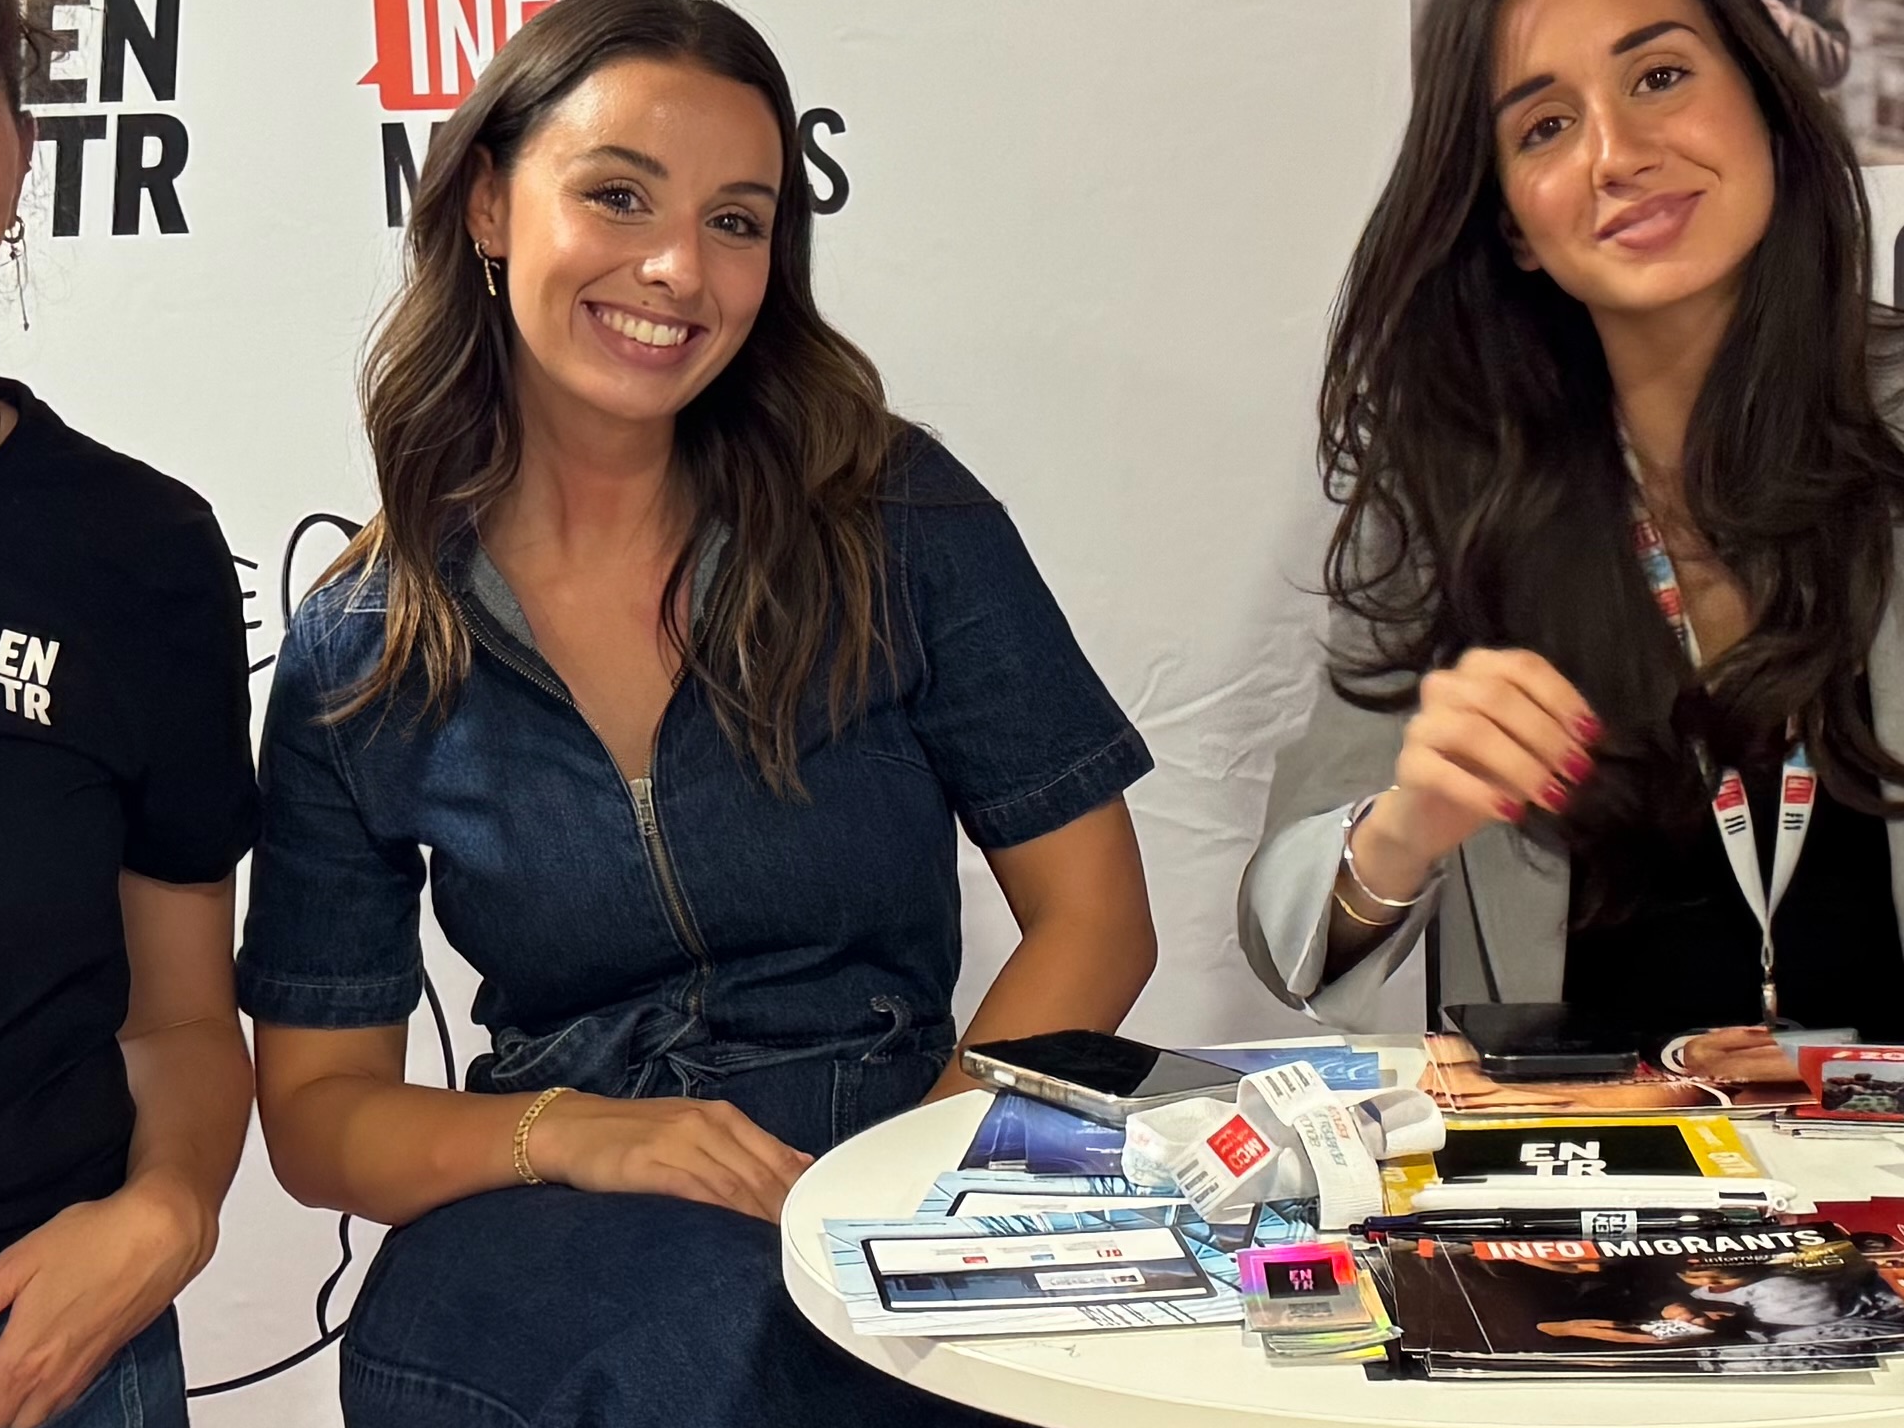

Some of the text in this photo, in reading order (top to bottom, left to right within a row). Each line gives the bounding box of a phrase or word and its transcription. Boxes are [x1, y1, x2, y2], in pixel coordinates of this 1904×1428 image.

[1520, 1140, 1601, 1162] EN
[1526, 1159, 1608, 1177] TR
[1486, 1229, 1827, 1261] INFO MIGRANTS
